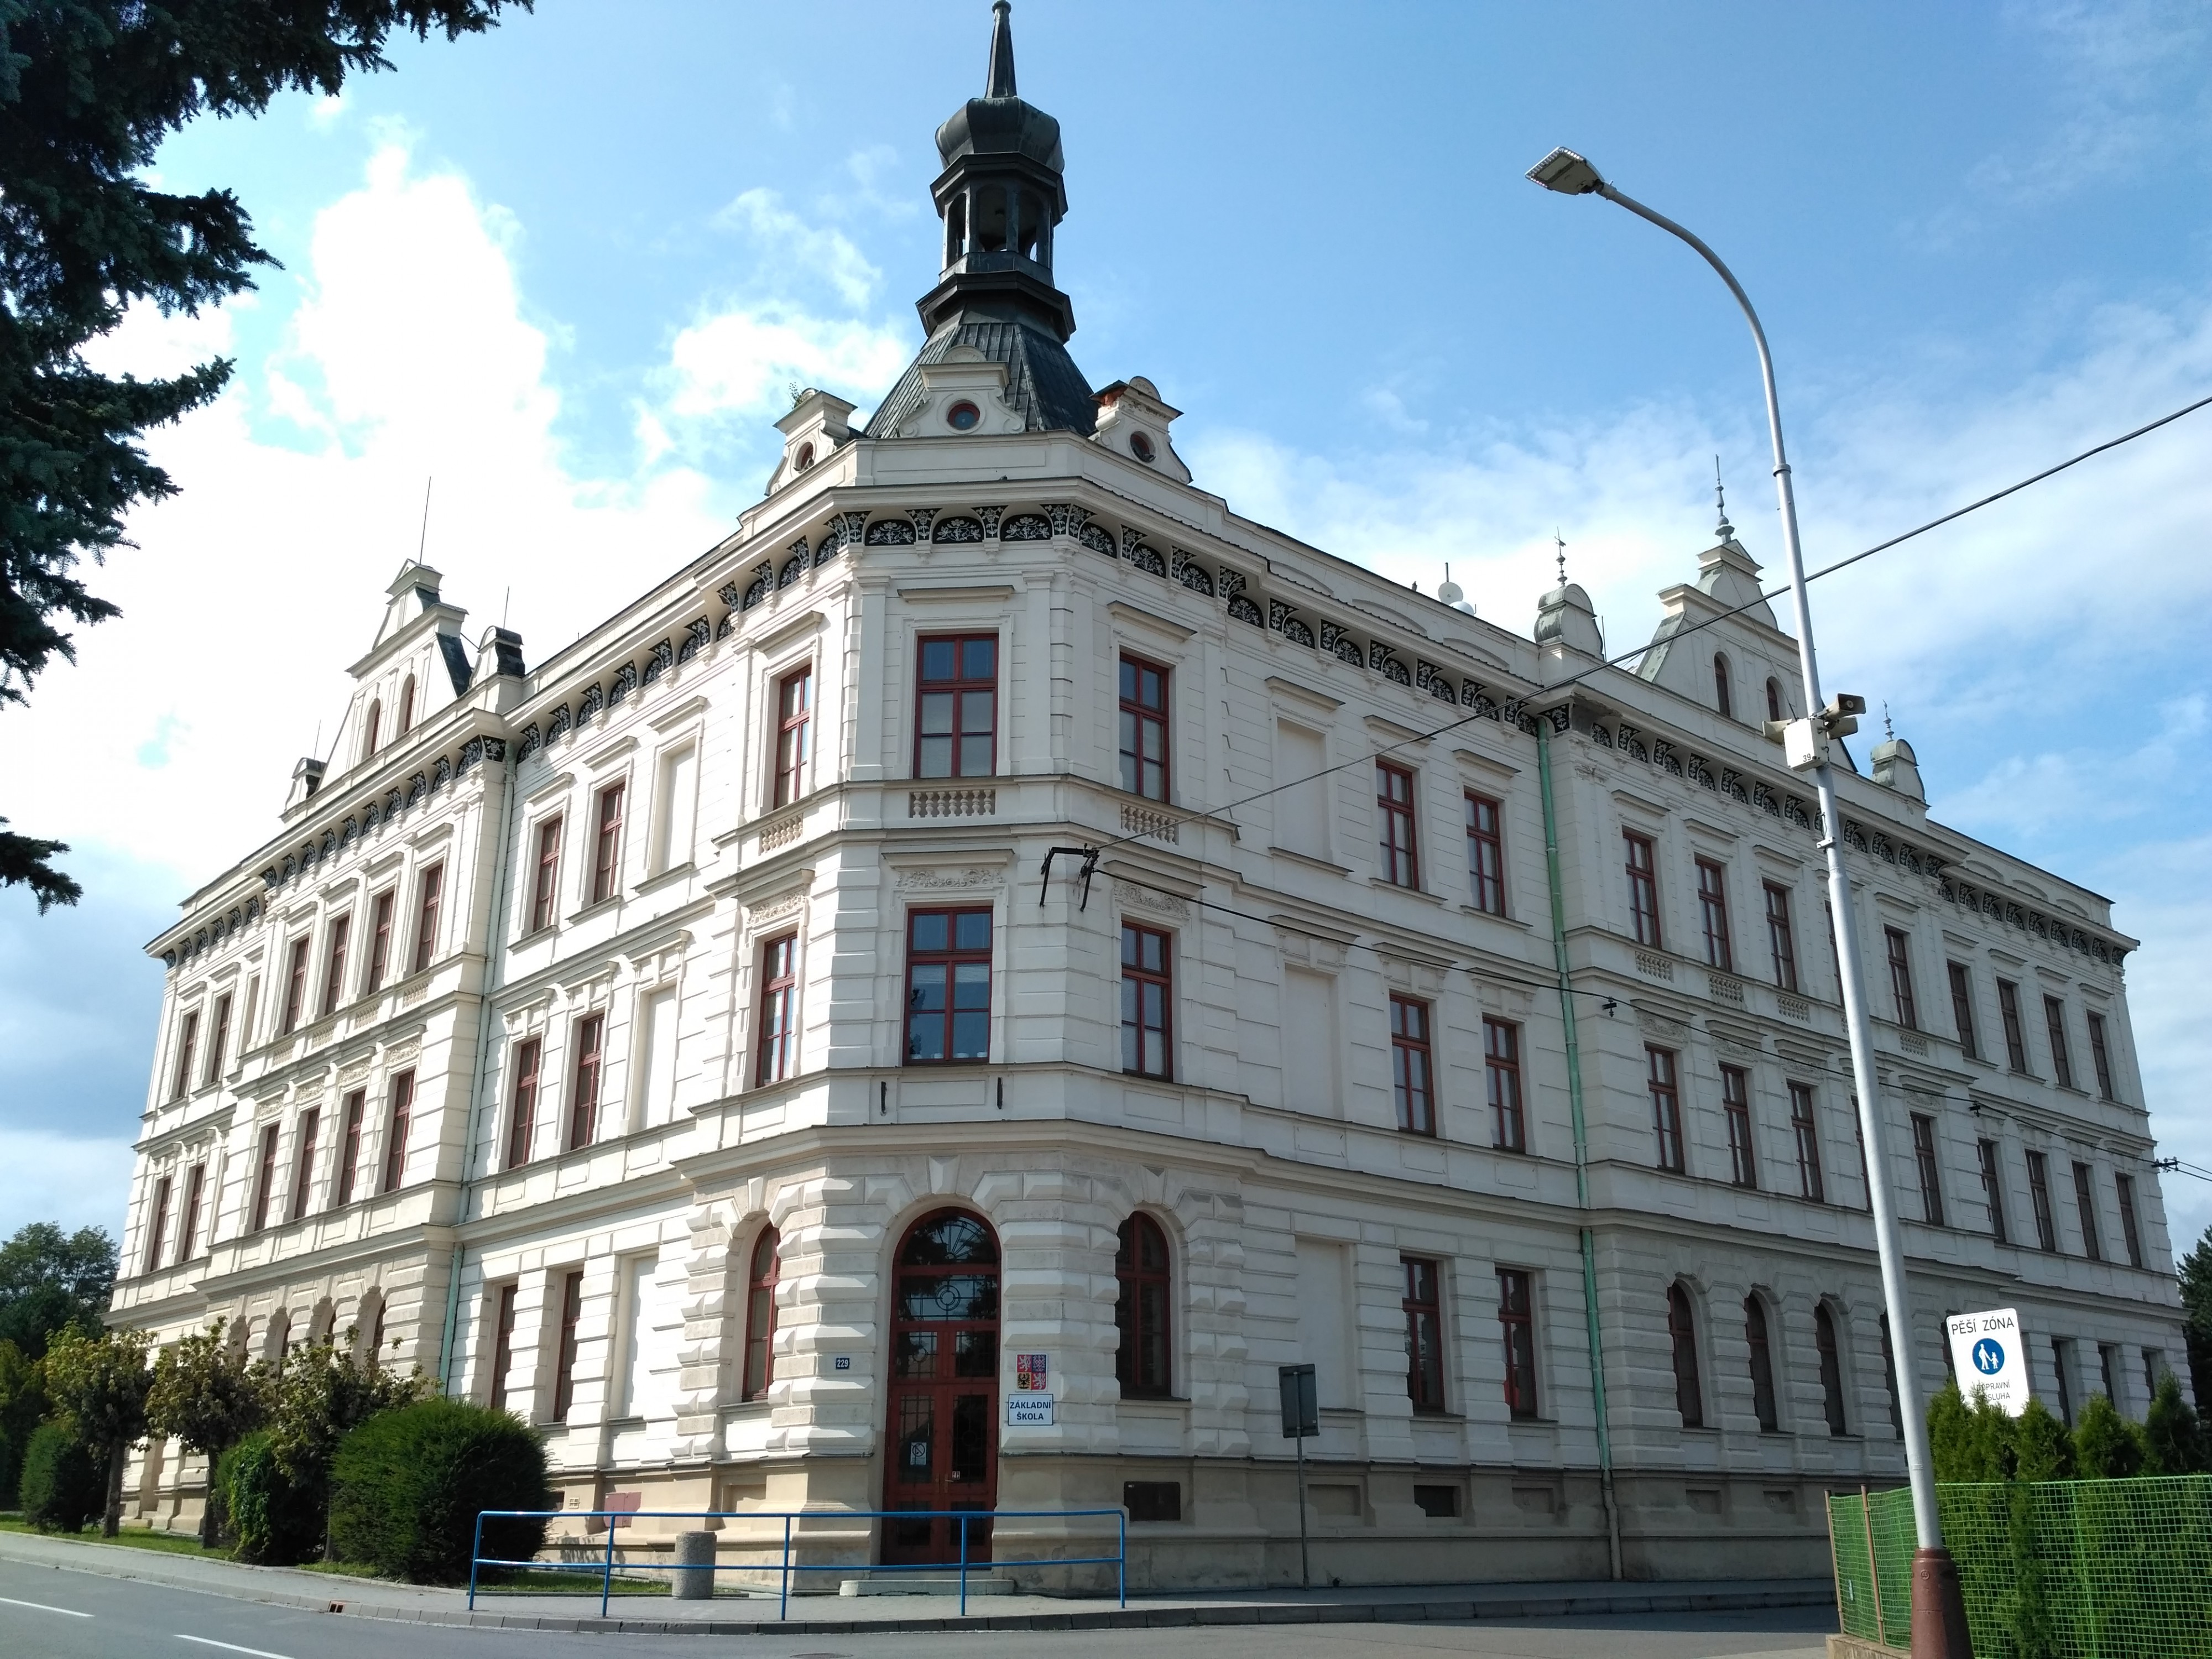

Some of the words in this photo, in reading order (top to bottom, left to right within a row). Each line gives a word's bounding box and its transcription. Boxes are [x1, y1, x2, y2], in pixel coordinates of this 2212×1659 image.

[1803, 753, 1811, 762] 39
[1951, 1318, 1976, 1335] PĚŠÍ
[1982, 1316, 2015, 1331] ZÓNA
[1978, 1392, 2011, 1402] SLUHA
[1010, 1400, 1051, 1408] ZÁKLADNÍ
[1016, 1411, 1044, 1420] ŠKOLA
